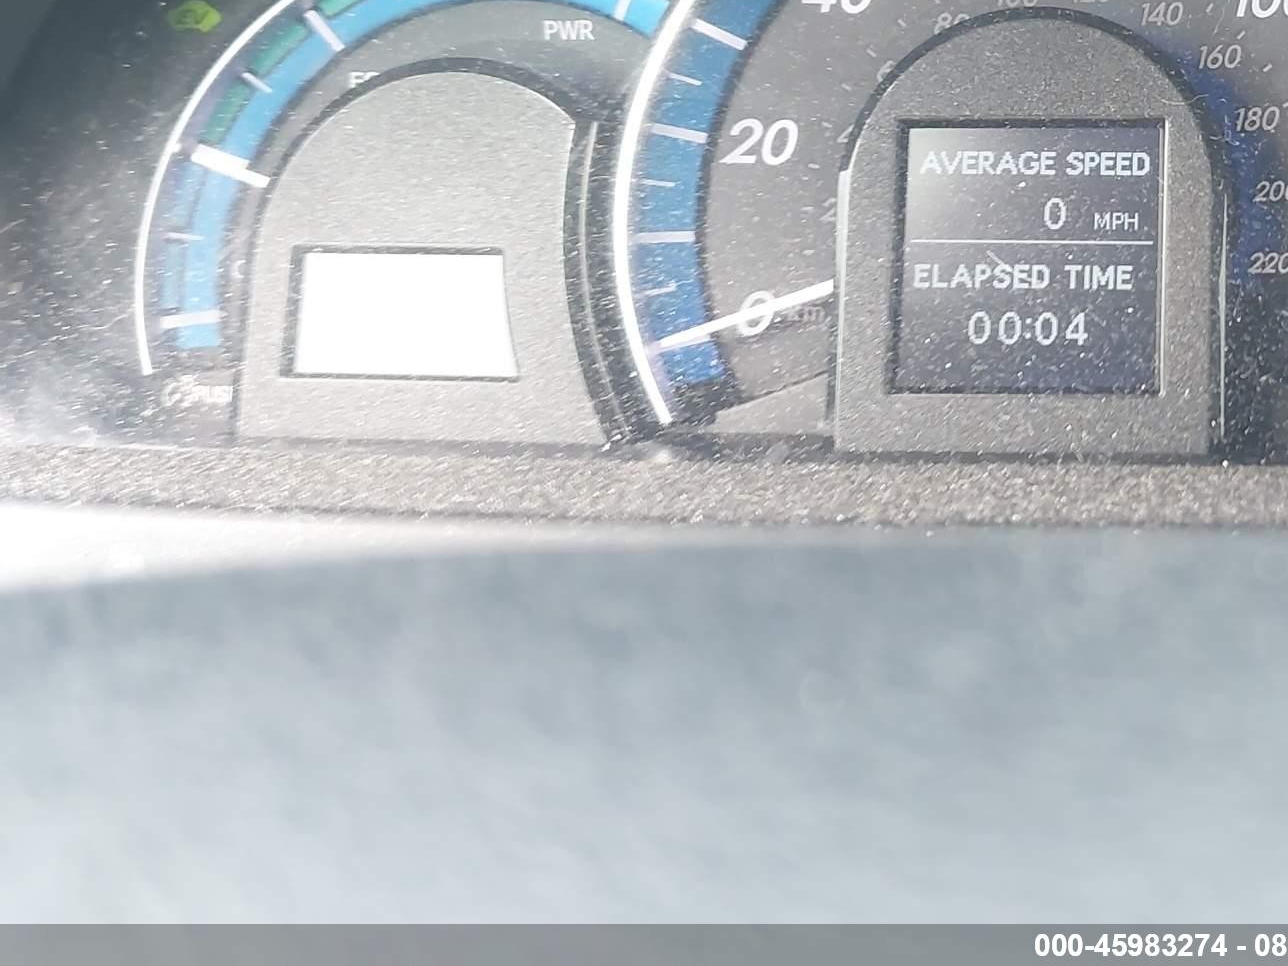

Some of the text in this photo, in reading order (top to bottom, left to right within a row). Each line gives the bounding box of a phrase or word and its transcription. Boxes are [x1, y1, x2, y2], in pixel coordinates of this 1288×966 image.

[1141, 2, 1183, 26] 140
[543, 19, 595, 41] PWR
[1199, 45, 1241, 69] 160
[1235, 106, 1280, 131] 180
[719, 119, 798, 165] 20
[920, 151, 1151, 176] AVERAGE SPEED
[1044, 198, 1139, 231] 0 MPH
[913, 264, 1133, 290] ELAPSED TIME
[967, 311, 1089, 346] 00:04
